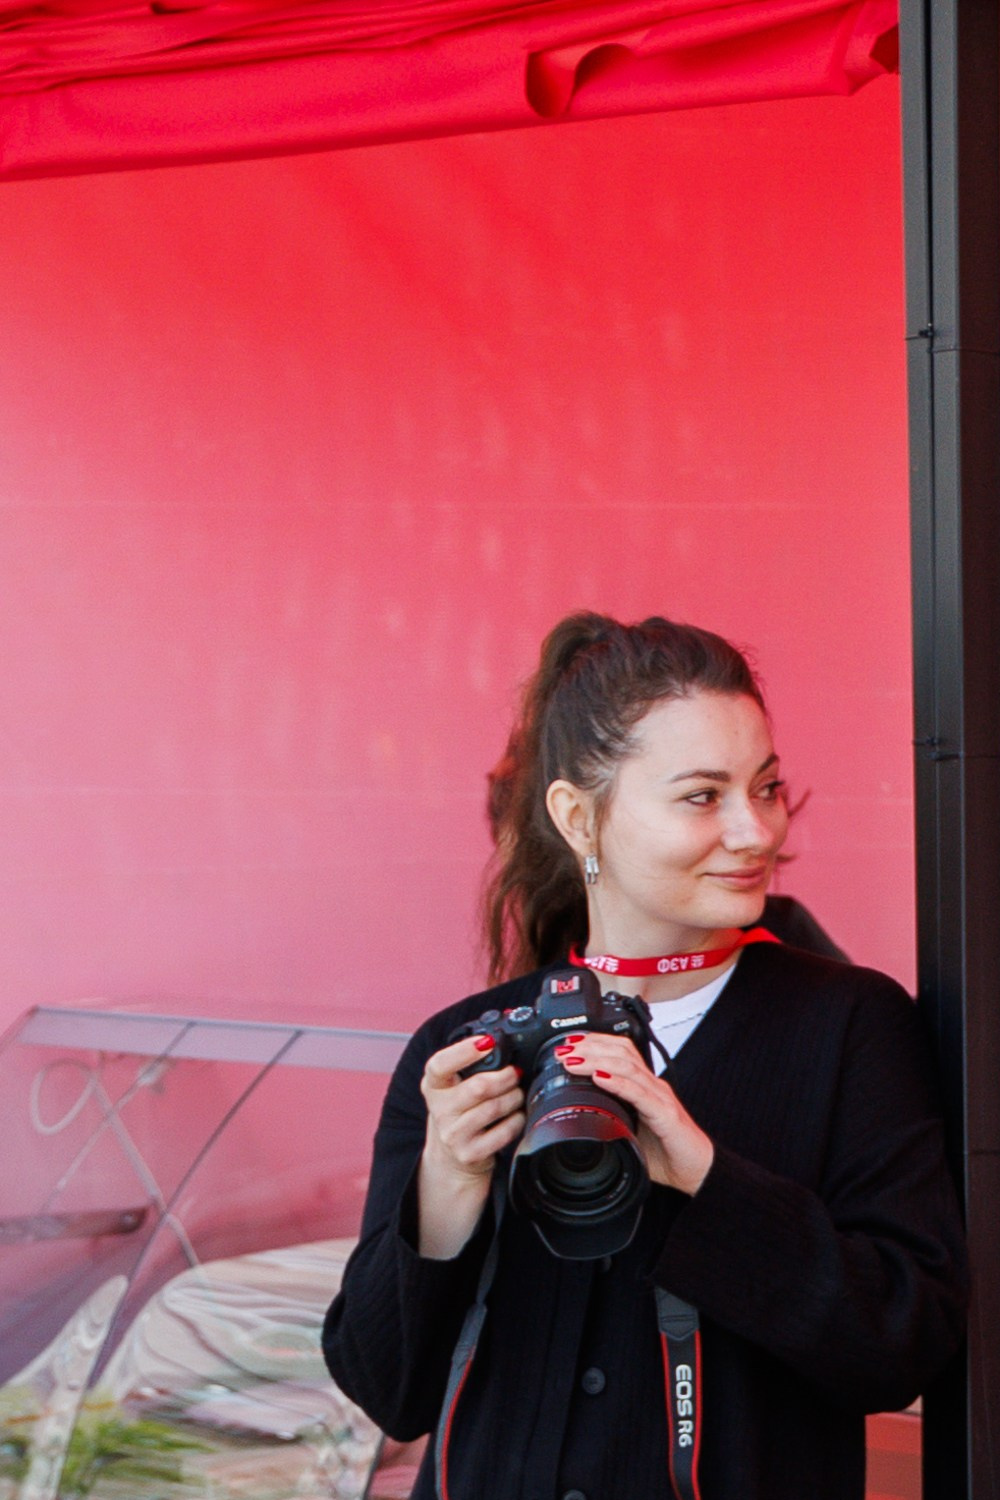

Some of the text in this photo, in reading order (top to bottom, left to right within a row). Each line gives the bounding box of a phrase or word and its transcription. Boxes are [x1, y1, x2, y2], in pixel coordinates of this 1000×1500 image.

[551, 1016, 587, 1028] Canon
[676, 1364, 693, 1447] EOS R6
